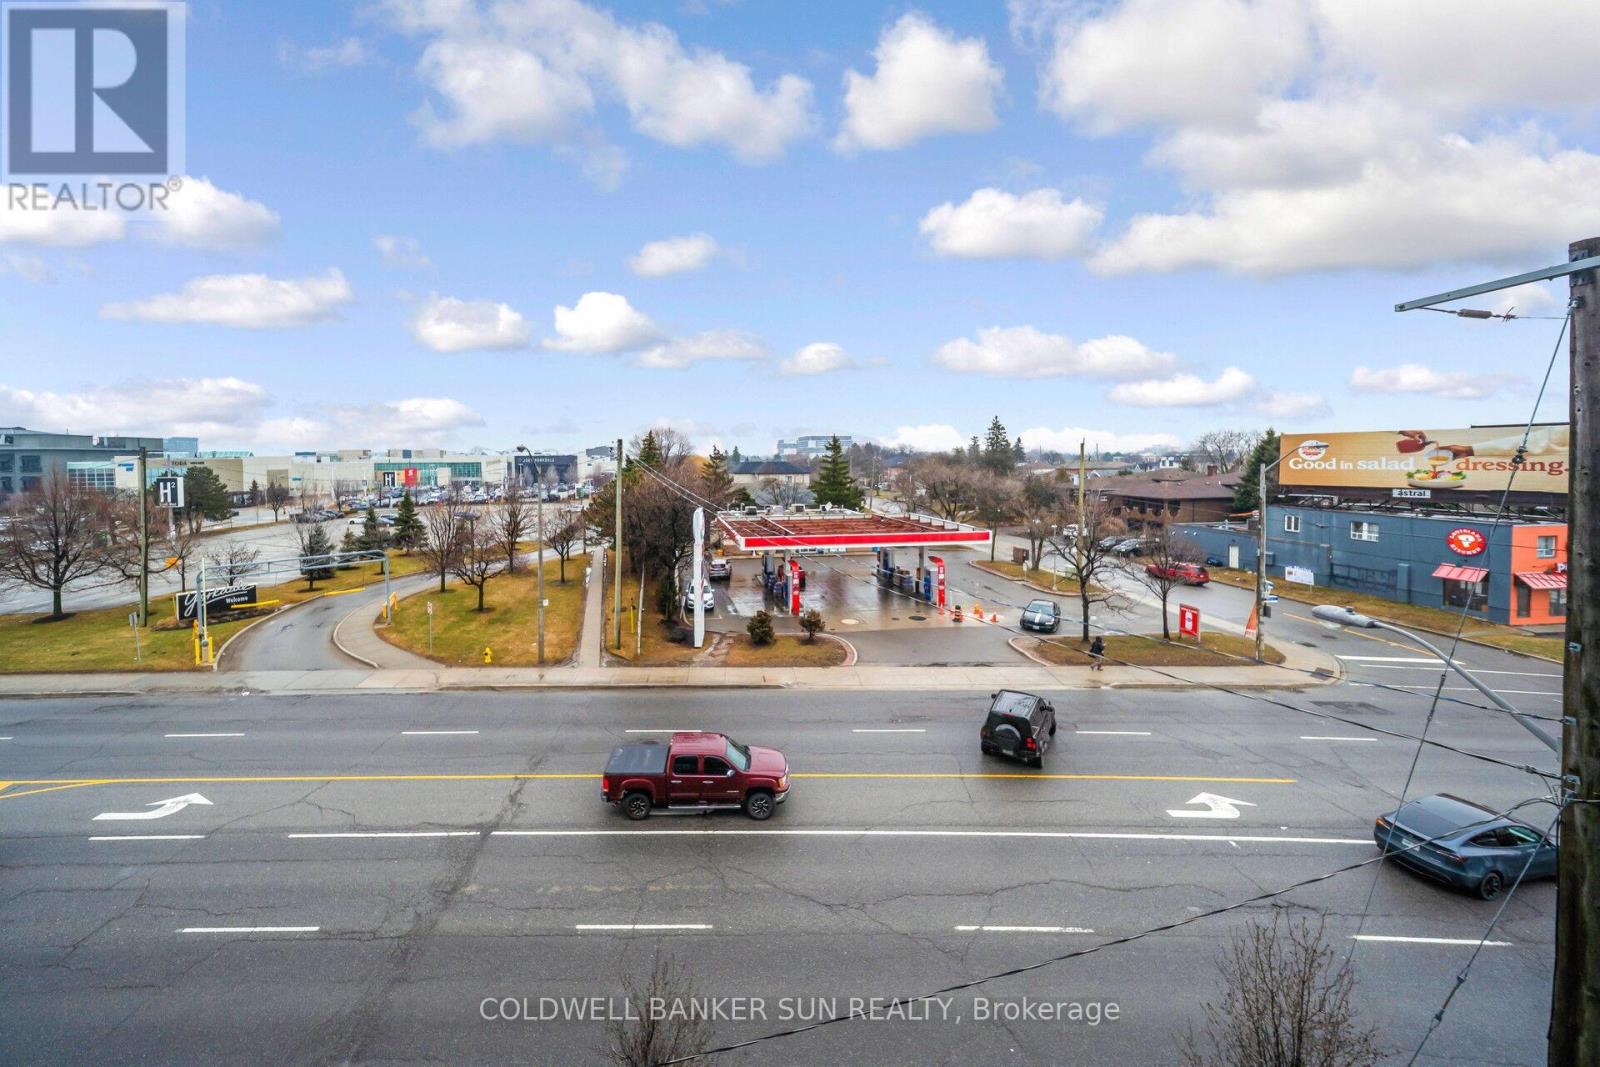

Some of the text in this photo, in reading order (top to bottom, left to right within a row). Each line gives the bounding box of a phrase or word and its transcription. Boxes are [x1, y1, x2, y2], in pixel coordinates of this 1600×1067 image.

[1289, 457, 1337, 470] Good
[1340, 460, 1354, 470] in
[1357, 456, 1415, 470] salad
